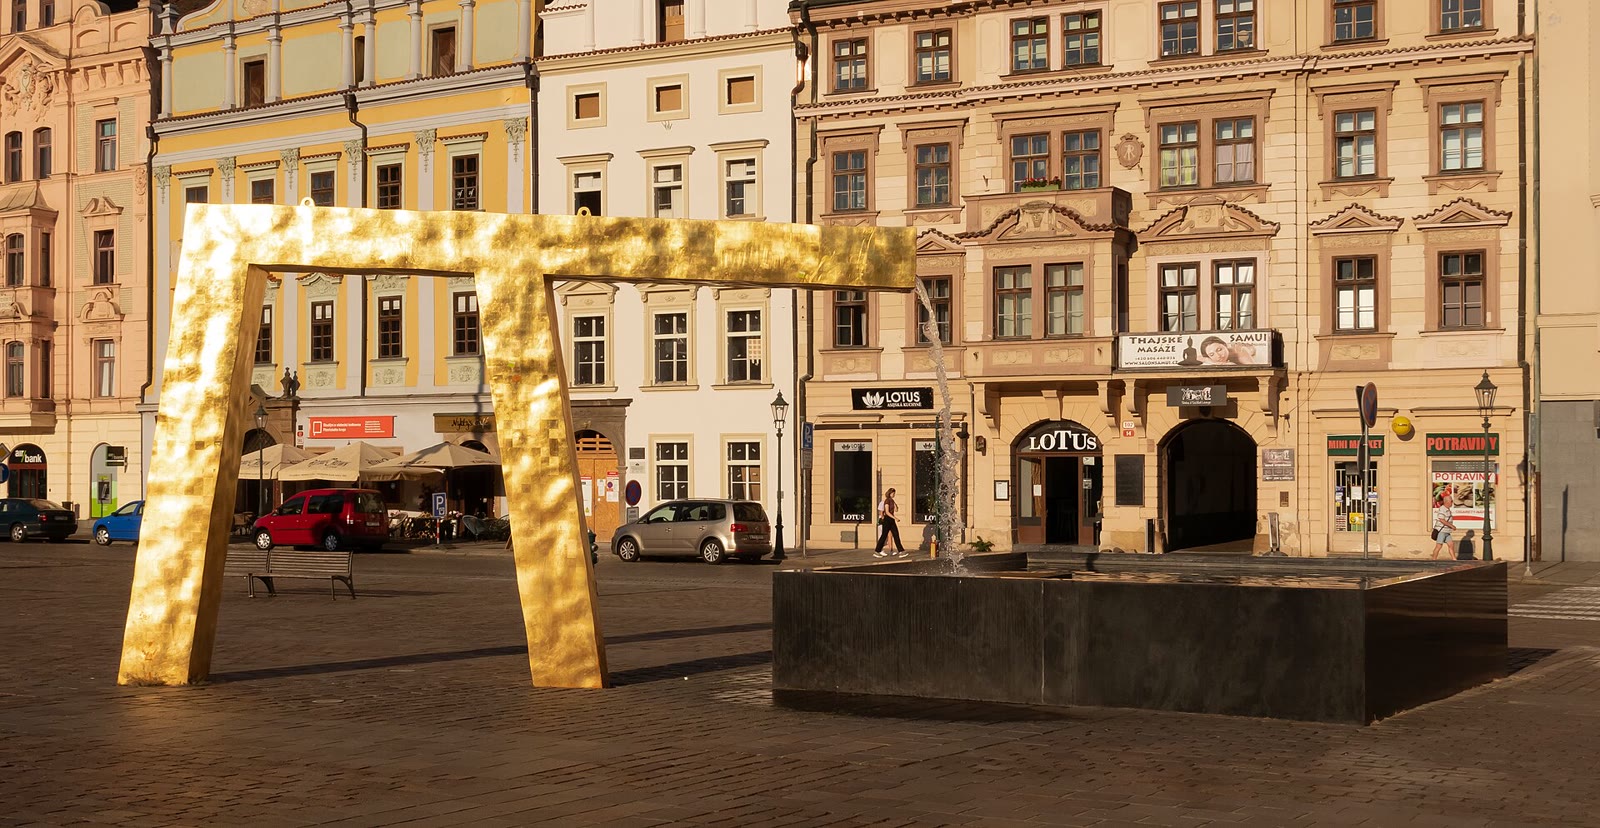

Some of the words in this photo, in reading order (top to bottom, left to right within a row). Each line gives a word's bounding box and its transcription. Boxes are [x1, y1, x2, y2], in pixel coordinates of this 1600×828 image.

[1229, 333, 1267, 342] SAMUI
[1137, 343, 1176, 353] MASÁŽE
[885, 391, 921, 403] LOTUS
[1028, 430, 1097, 451] LOTUS
[1328, 440, 1348, 449] MINI
[1349, 440, 1383, 449] MKET
[24, 453, 43, 463] bank
[1435, 472, 1493, 481] POTRAVINY
[436, 495, 444, 510] P
